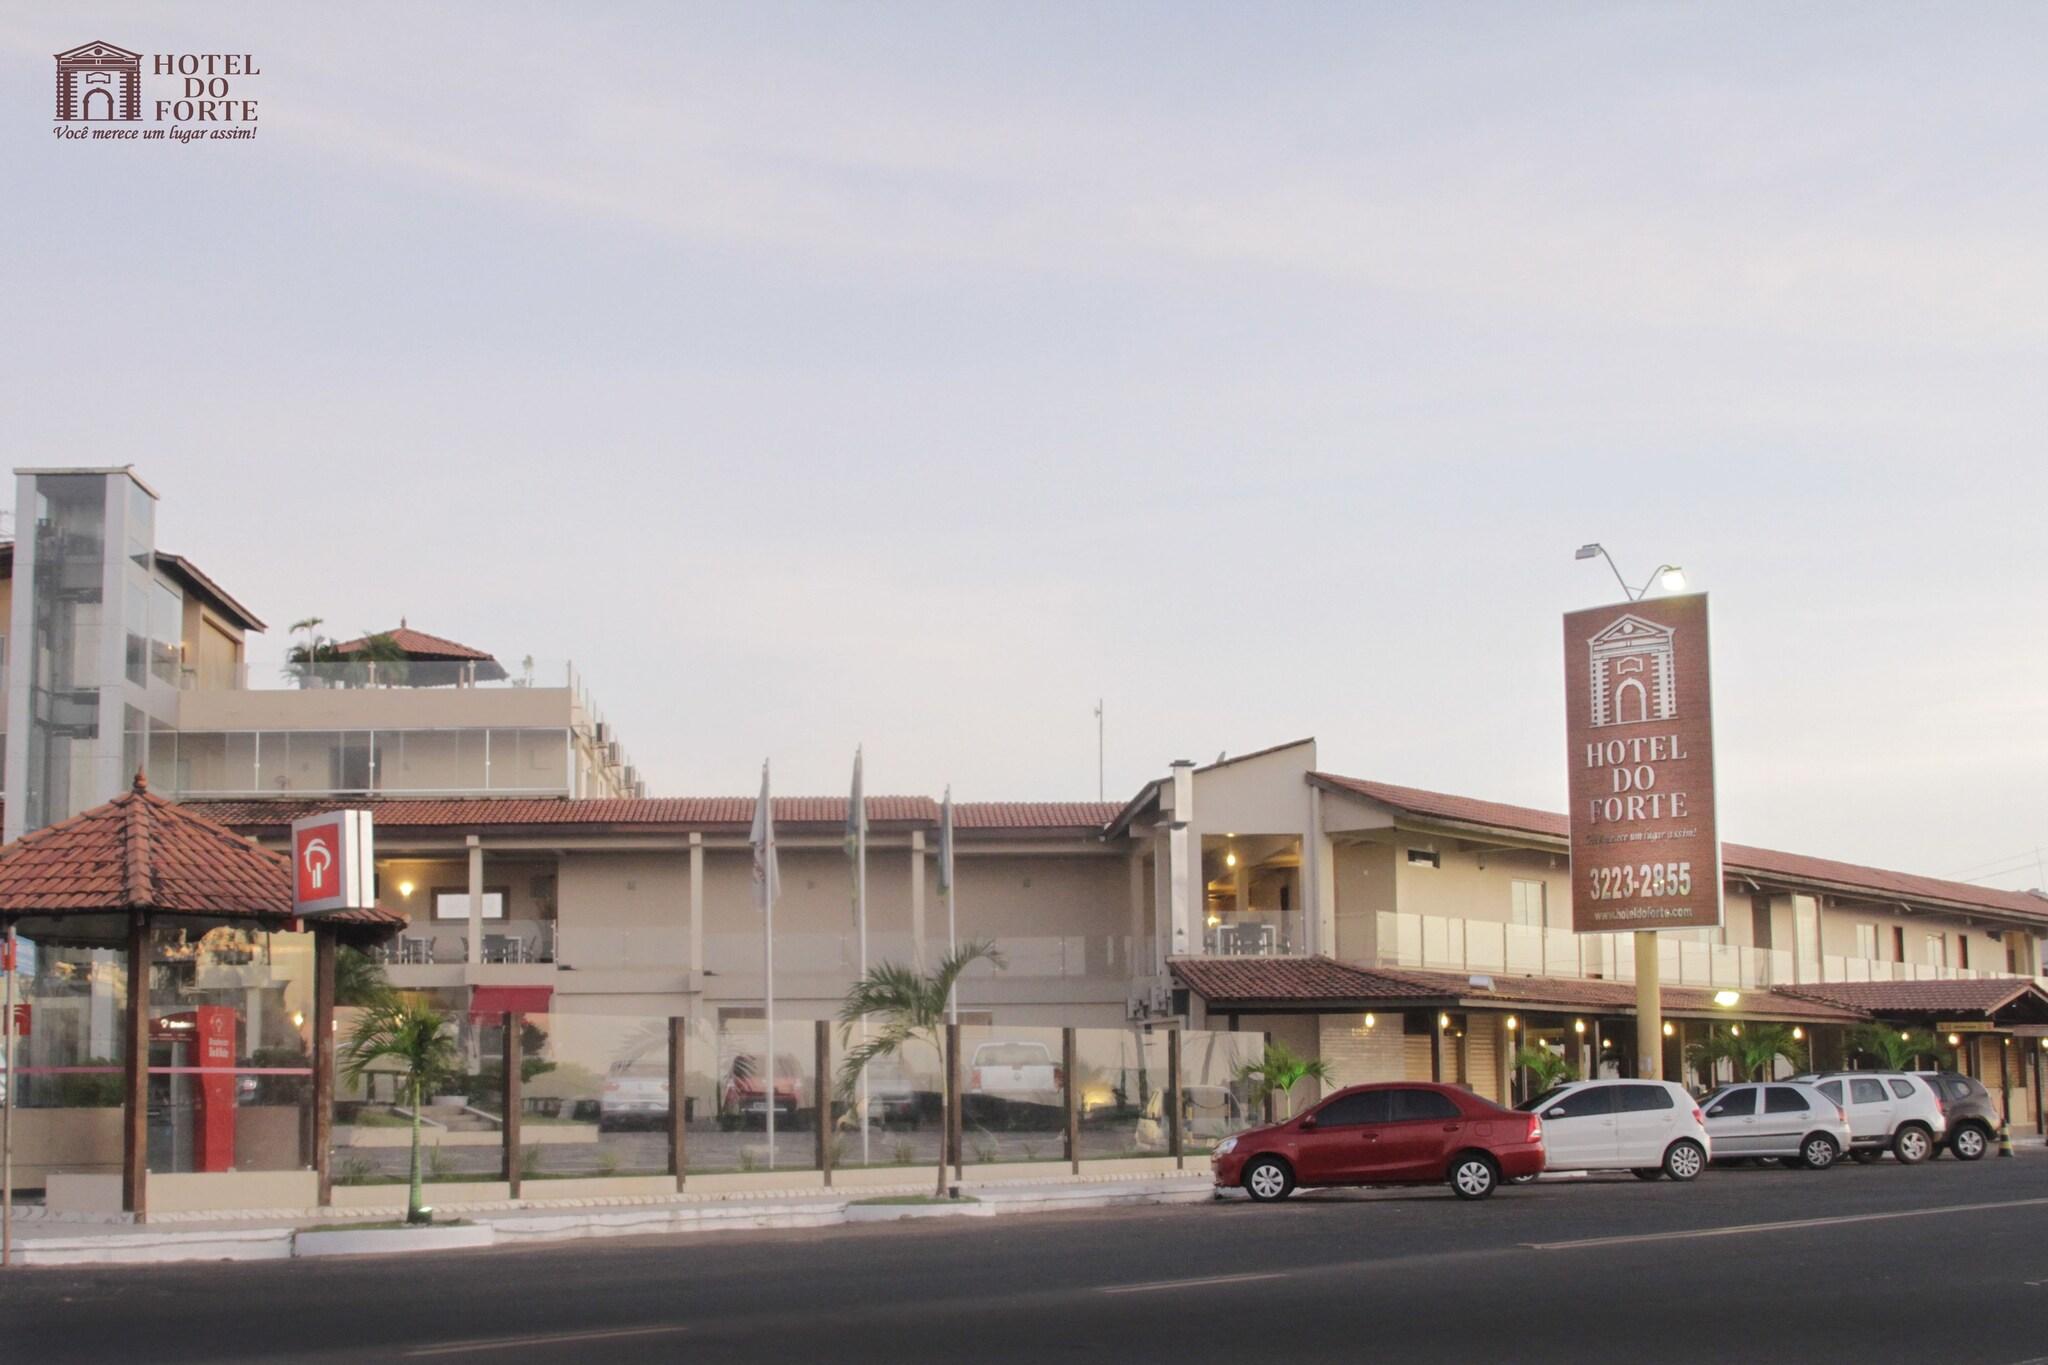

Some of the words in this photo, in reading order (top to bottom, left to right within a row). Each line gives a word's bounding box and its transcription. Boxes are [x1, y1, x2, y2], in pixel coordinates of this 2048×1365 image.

[1586, 734, 1689, 769] HOTEL
[1612, 764, 1656, 793] DO
[1589, 791, 1689, 825] FORTE
[1589, 862, 1692, 900] 3223-2855
